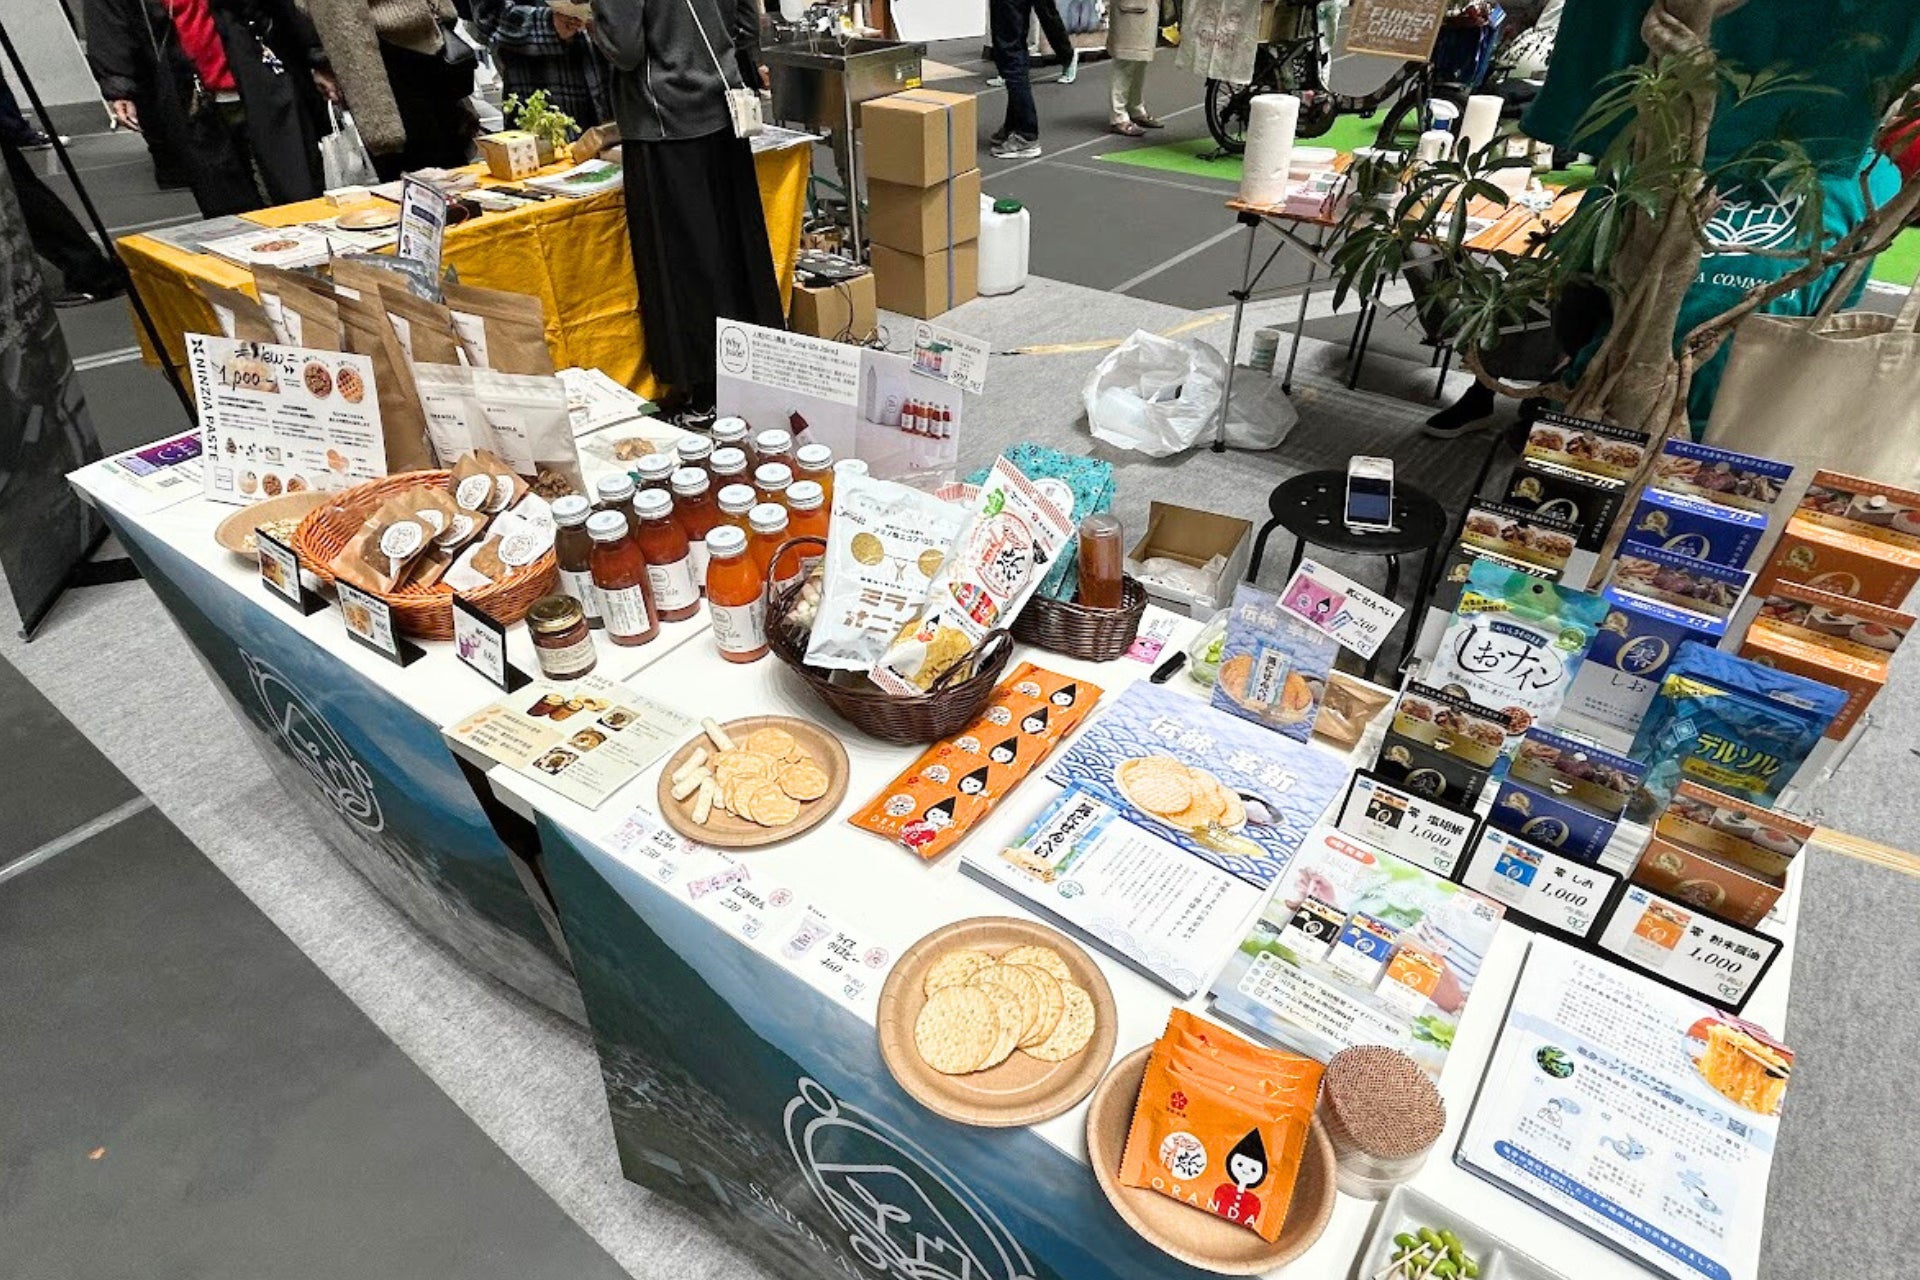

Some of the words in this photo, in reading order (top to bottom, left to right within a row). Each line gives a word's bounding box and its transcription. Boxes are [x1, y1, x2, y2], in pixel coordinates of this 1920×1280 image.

[194, 357, 214, 412] NINZIA
[205, 415, 220, 462] PASTE
[1611, 674, 1648, 694] しお
[1149, 714, 1217, 755] 伝統
[1696, 731, 1781, 776] デルソル
[1408, 823, 1452, 848] 1,000
[1539, 882, 1589, 908] 1,000
[1571, 874, 1595, 890] しお
[1688, 946, 1743, 974] 1,000
[1151, 1176, 1257, 1228] ORANDA
